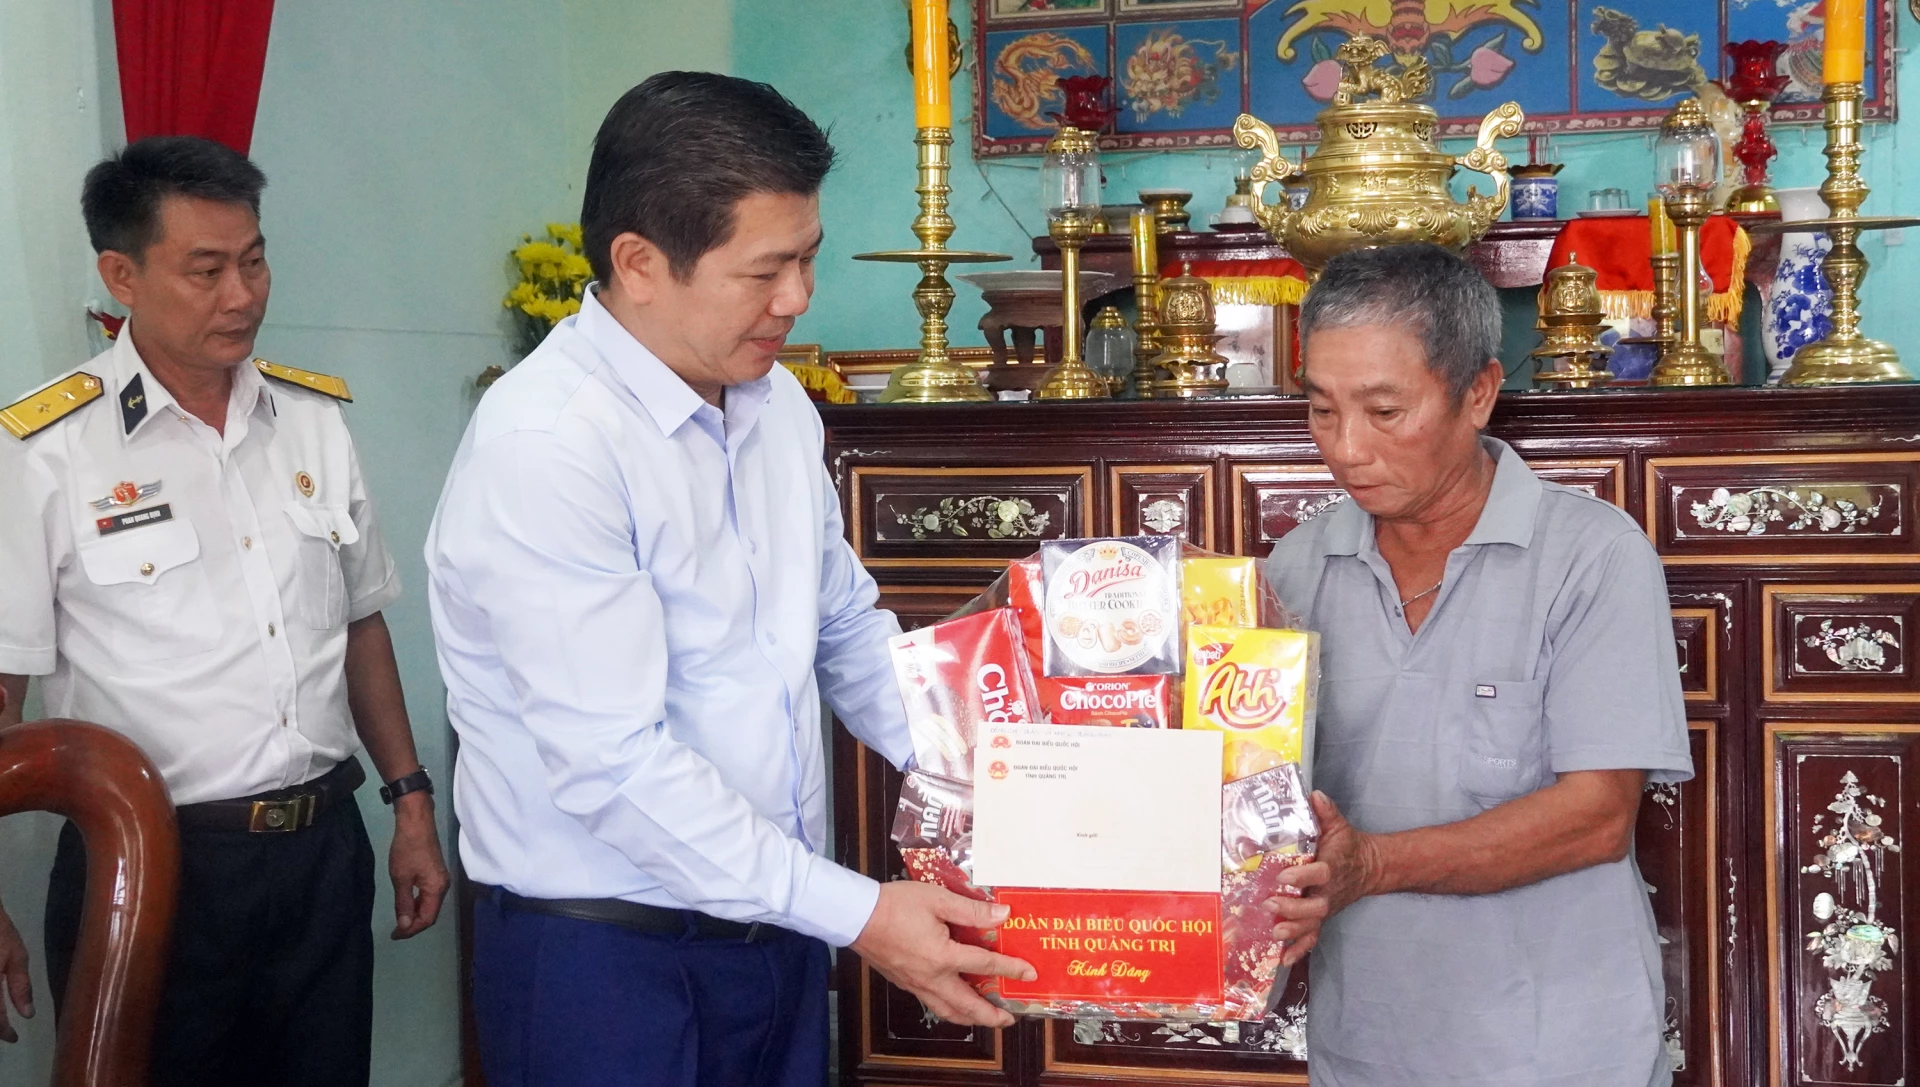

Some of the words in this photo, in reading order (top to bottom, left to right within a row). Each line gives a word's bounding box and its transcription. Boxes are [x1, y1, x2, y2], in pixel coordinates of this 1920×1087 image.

[1064, 560, 1143, 599] Danisa
[1096, 682, 1129, 691] ORION
[1482, 755, 1517, 767] SPORTS
[1003, 913, 1049, 930] ĐOÀN
[1053, 916, 1082, 933] ĐẠI
[1086, 915, 1125, 931] BIỂU
[1129, 916, 1177, 934] QUỐC
[1181, 918, 1213, 937] HỘI
[1040, 934, 1080, 950] TỈNH
[1084, 934, 1144, 953] QUẢNG
[1147, 938, 1176, 956] TRỊ
[1110, 960, 1151, 983] Dâng
